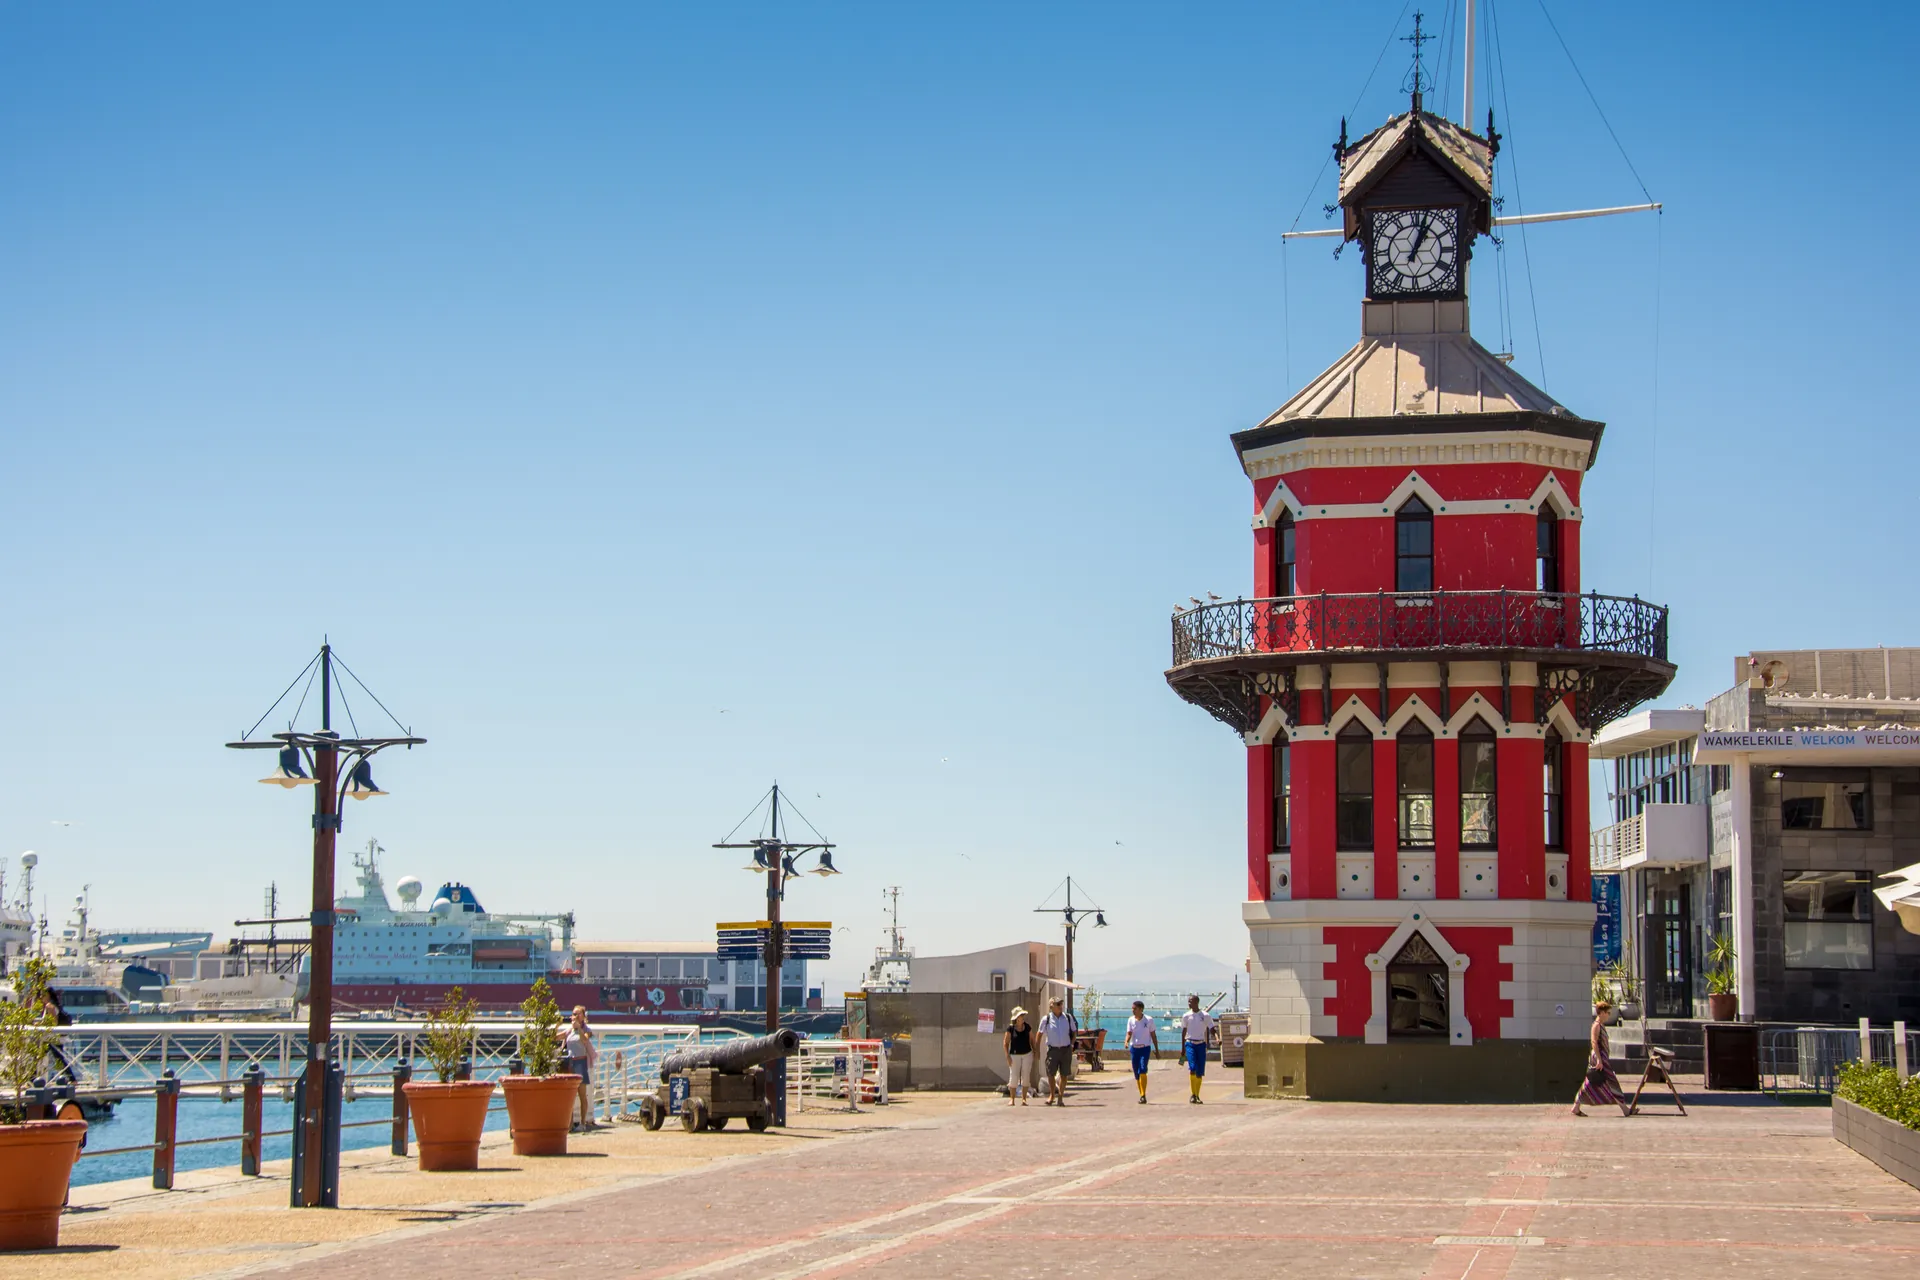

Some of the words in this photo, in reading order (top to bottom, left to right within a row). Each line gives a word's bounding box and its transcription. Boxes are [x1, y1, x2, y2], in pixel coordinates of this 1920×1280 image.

[1704, 736, 1793, 746] WAMKELEKILE
[1801, 735, 1855, 745] WELKOM
[1594, 876, 1611, 917] Island
[1594, 924, 1615, 969] Robben
